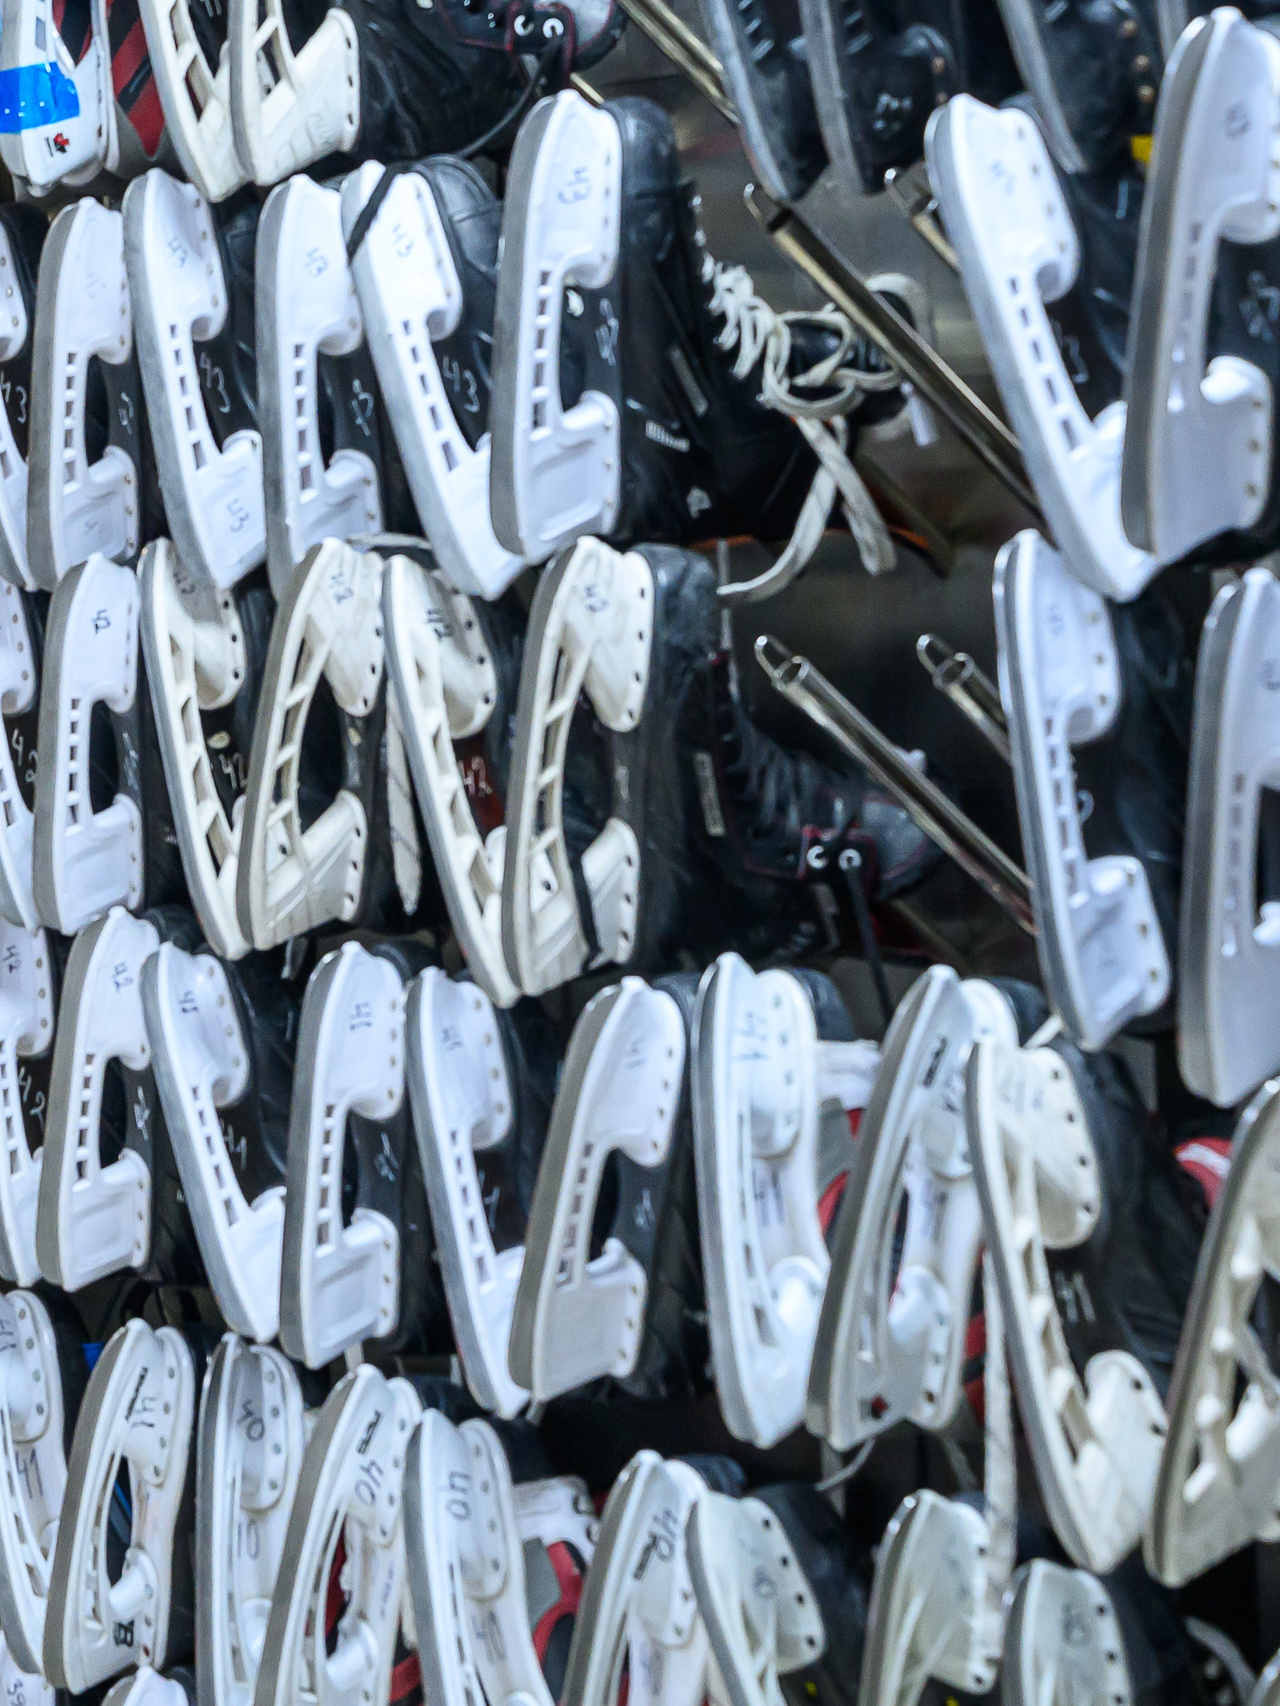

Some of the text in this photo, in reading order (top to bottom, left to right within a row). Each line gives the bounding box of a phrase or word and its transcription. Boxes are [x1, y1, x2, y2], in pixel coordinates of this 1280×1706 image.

[557, 165, 591, 204] 43
[391, 223, 414, 258] 43
[200, 352, 231, 413] 43
[442, 356, 480, 413] 43
[226, 498, 251, 533] 43
[219, 753, 248, 789] 42
[237, 1400, 265, 1442] 40
[354, 1459, 384, 1506] 40
[440, 1471, 472, 1521] 40
[652, 1507, 678, 1562] 40
